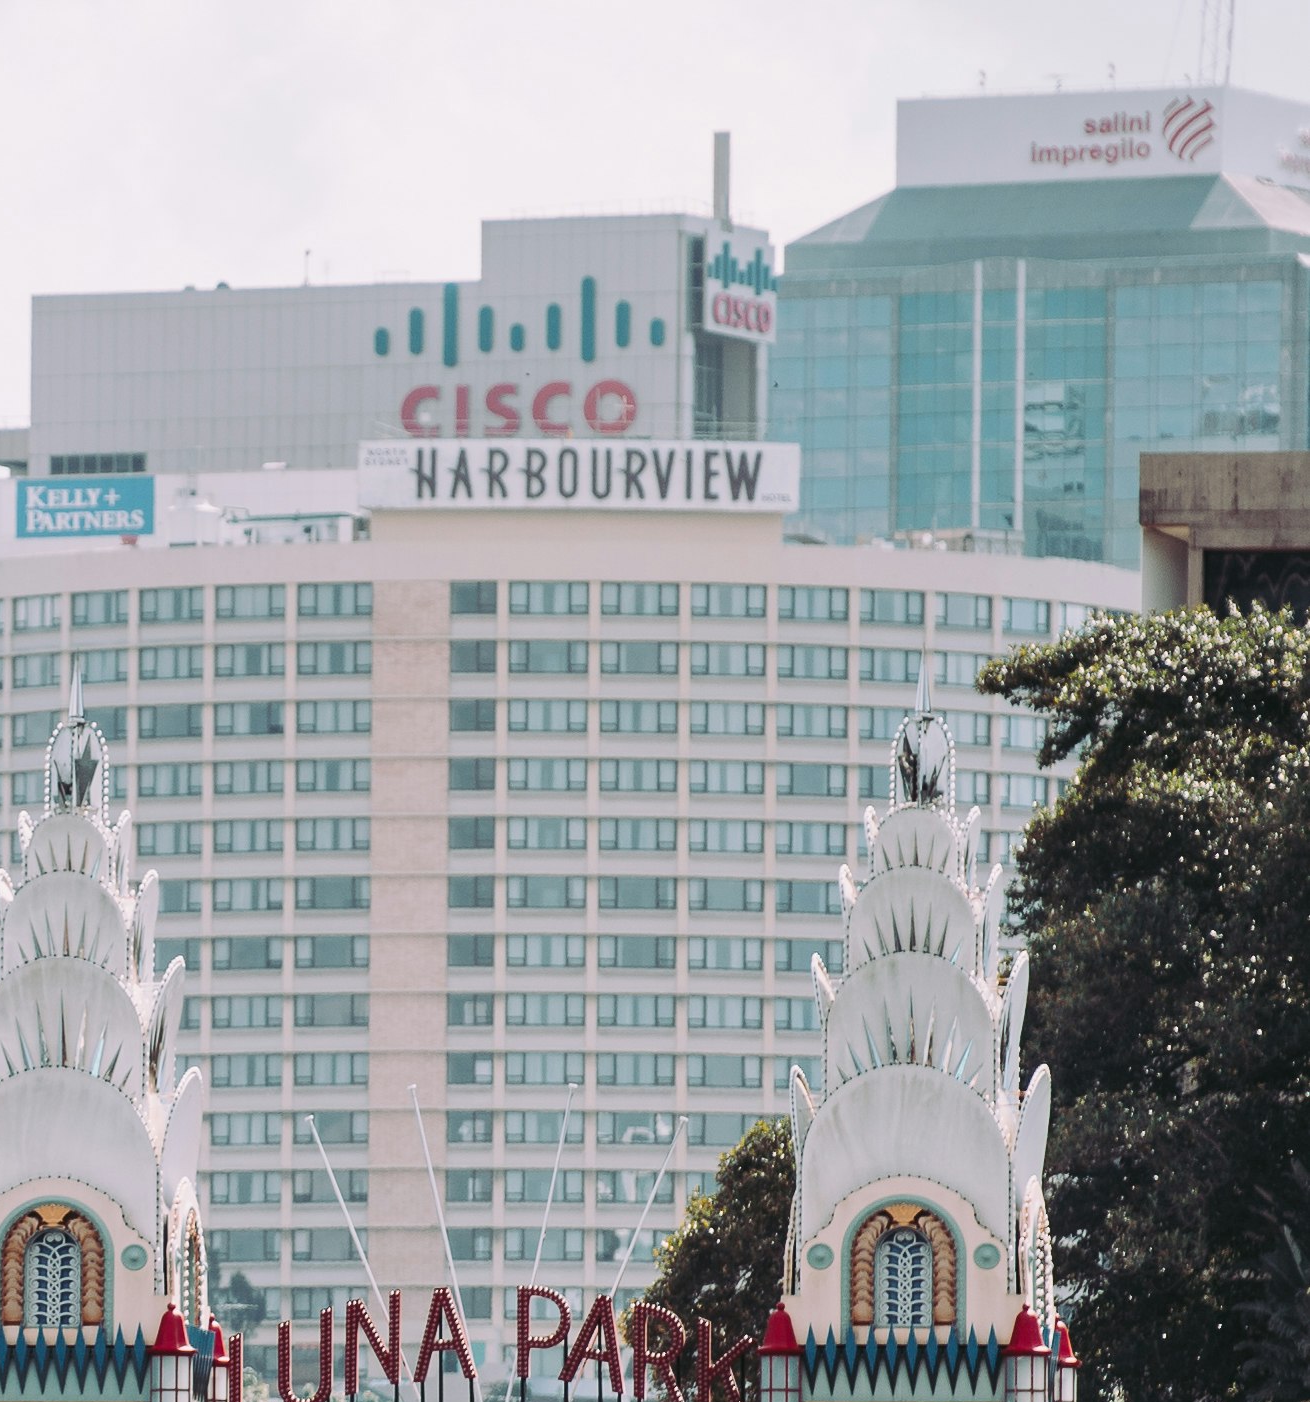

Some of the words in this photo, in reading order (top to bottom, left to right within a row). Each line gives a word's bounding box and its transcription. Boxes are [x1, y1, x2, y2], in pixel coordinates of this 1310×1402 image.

[1083, 111, 1152, 136] salini
[1030, 137, 1151, 166] impregilo
[712, 292, 772, 333] CISCO
[401, 379, 638, 438] CISCO
[410, 447, 763, 501] HARBOURVIEW
